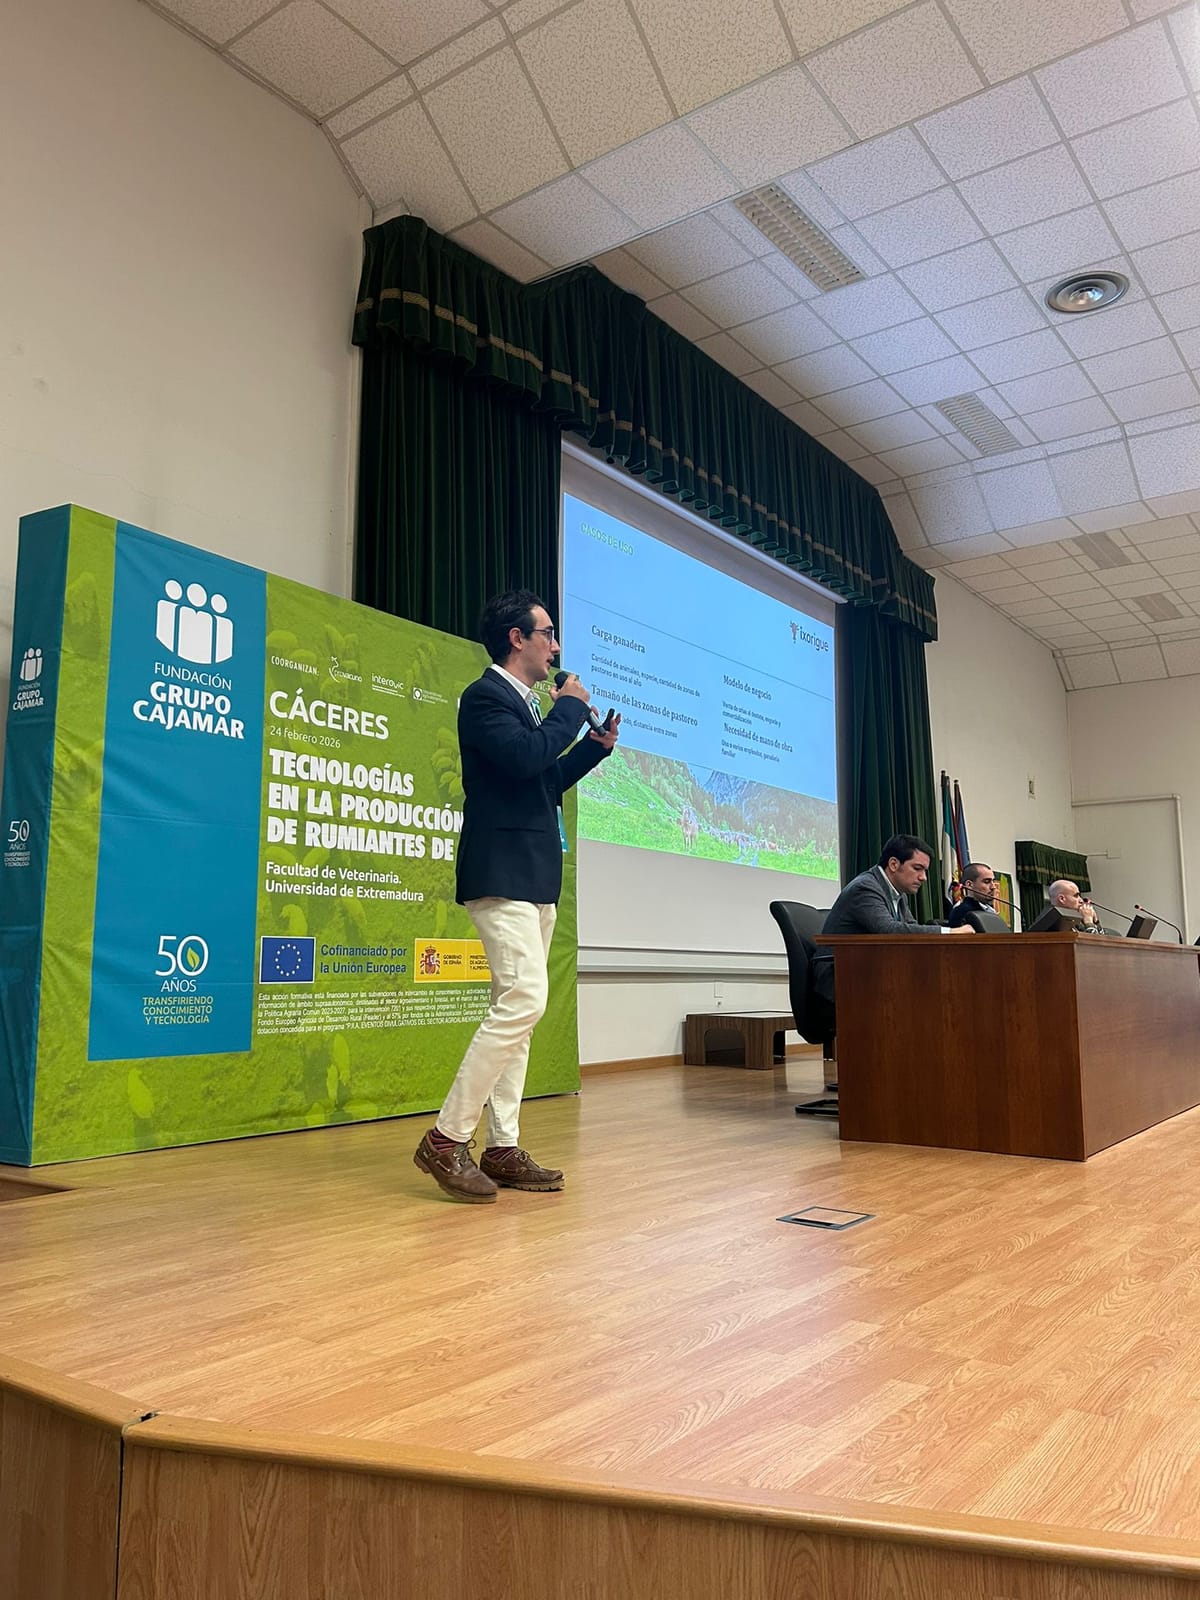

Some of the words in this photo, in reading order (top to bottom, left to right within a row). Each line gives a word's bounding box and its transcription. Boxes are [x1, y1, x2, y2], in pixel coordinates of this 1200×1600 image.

[580, 522, 607, 543] CASOS
[618, 540, 634, 556] USO
[591, 624, 612, 642] Carga
[613, 634, 646, 654] ganadera
[800, 626, 829, 652] ixorigue
[154, 661, 232, 691] FUNDACIÓN
[271, 655, 320, 677] COORGANIZAN:
[12, 697, 44, 711] CAJAMAR
[17, 689, 41, 701] GRUPO
[150, 681, 231, 715] GRUPO
[591, 684, 621, 703] Tamaño
[621, 693, 631, 706] de
[631, 696, 641, 710] las
[642, 702, 661, 715] zonas
[661, 706, 670, 718] de
[671, 711, 698, 727] pastoreo
[132, 699, 244, 740] CAJAMAR
[269, 687, 389, 740] CÁCERES
[270, 726, 282, 738] 24
[284, 727, 318, 745] febrero
[319, 735, 341, 749] 2026
[269, 748, 414, 797] TECNOLOGÍAS
[268, 782, 299, 812] EN
[307, 788, 334, 816] LA
[340, 793, 464, 833] PRODUCCIÓN
[8, 819, 30, 842] 50
[267, 816, 298, 845] DE
[305, 821, 426, 858] RUMIANTES
[431, 836, 455, 861] DE
[266, 861, 318, 879] Facultad
[321, 865, 336, 880] de
[338, 867, 402, 885] Veterinaria.
[265, 879, 337, 897] Universidad
[340, 883, 354, 898] de
[356, 886, 424, 902] Extremadura
[155, 935, 209, 977] 50
[320, 944, 388, 957] Cofinanciado
[390, 947, 407, 958] por
[320, 962, 329, 974] la
[332, 961, 362, 974] Unión
[366, 962, 407, 975] Europea
[160, 977, 197, 992] AÑOS
[142, 996, 214, 1006] TRANSFIRIENDO
[142, 1005, 213, 1016] CONOCIMIENTO
[145, 1016, 152, 1025] Y
